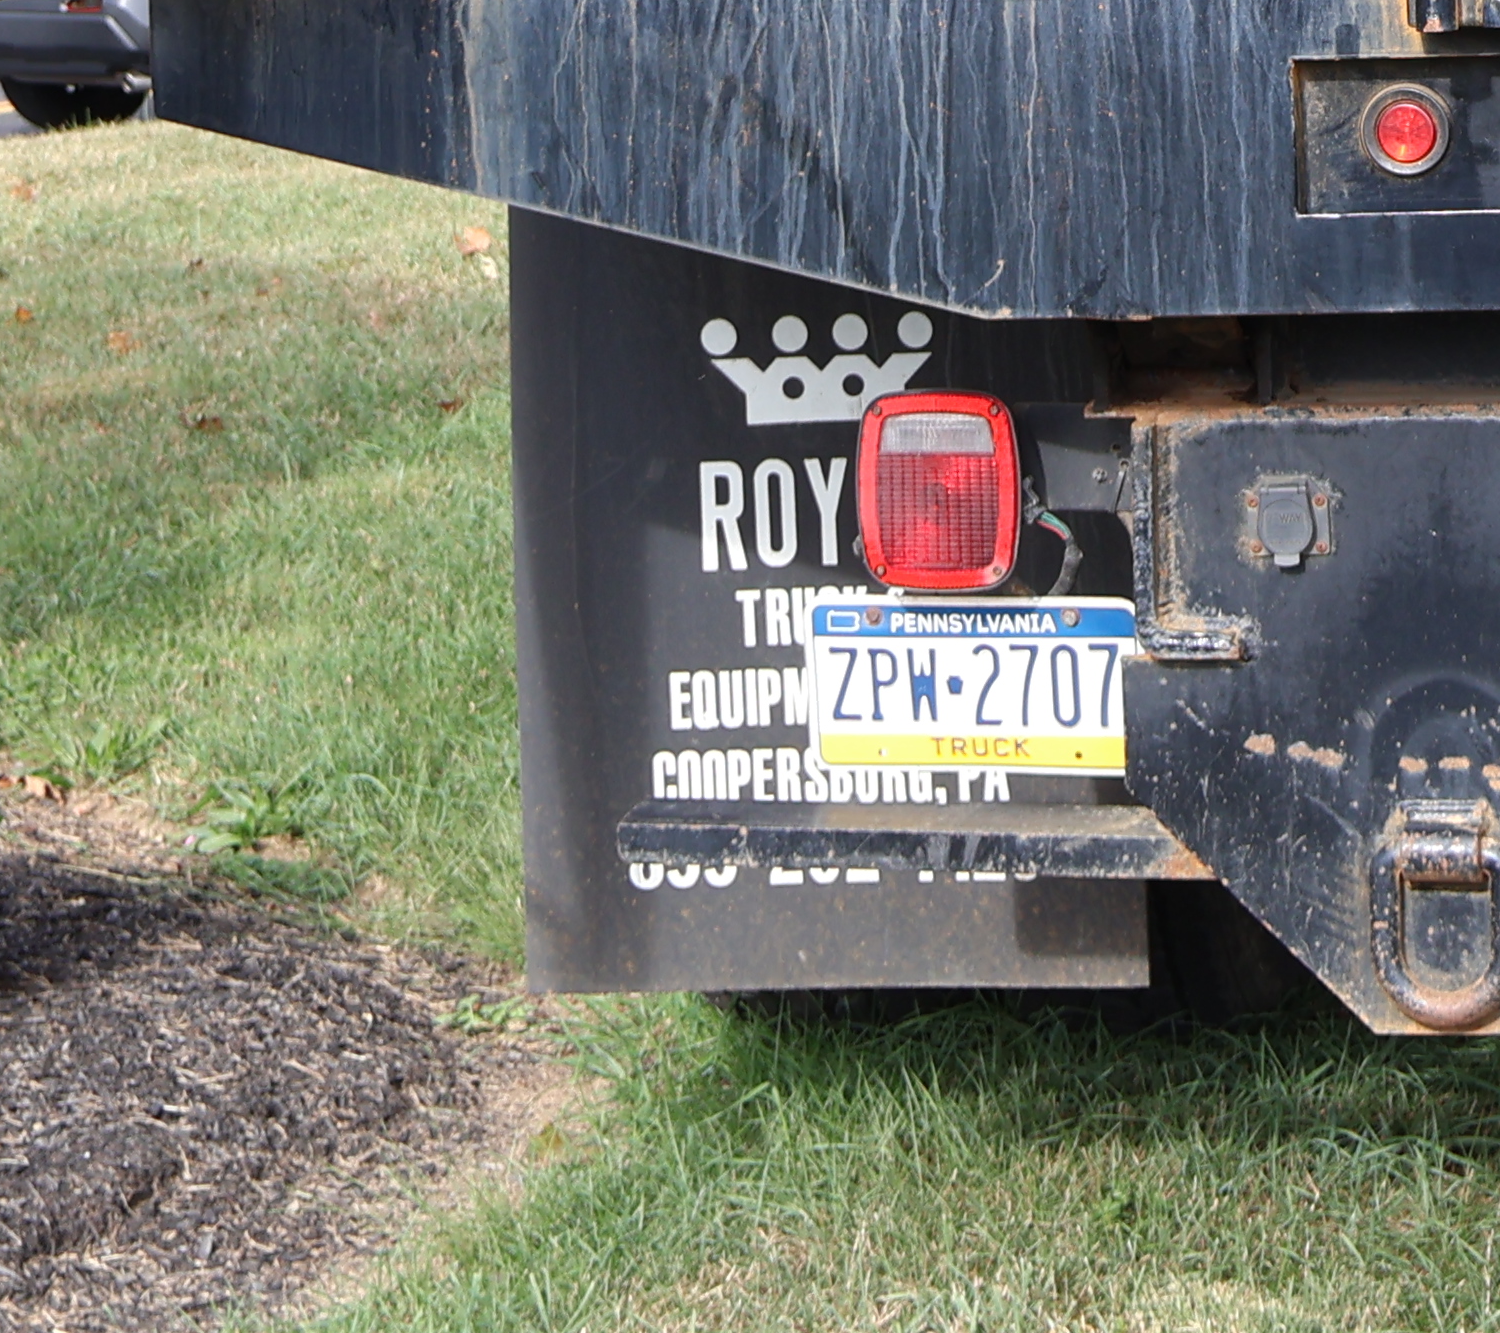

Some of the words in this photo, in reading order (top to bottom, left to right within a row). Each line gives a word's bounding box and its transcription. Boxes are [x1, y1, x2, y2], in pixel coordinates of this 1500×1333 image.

[700, 457, 848, 573] ROY
[889, 611, 1058, 634] PENNSYLVANIA
[931, 737, 1031, 758] TRUCK
